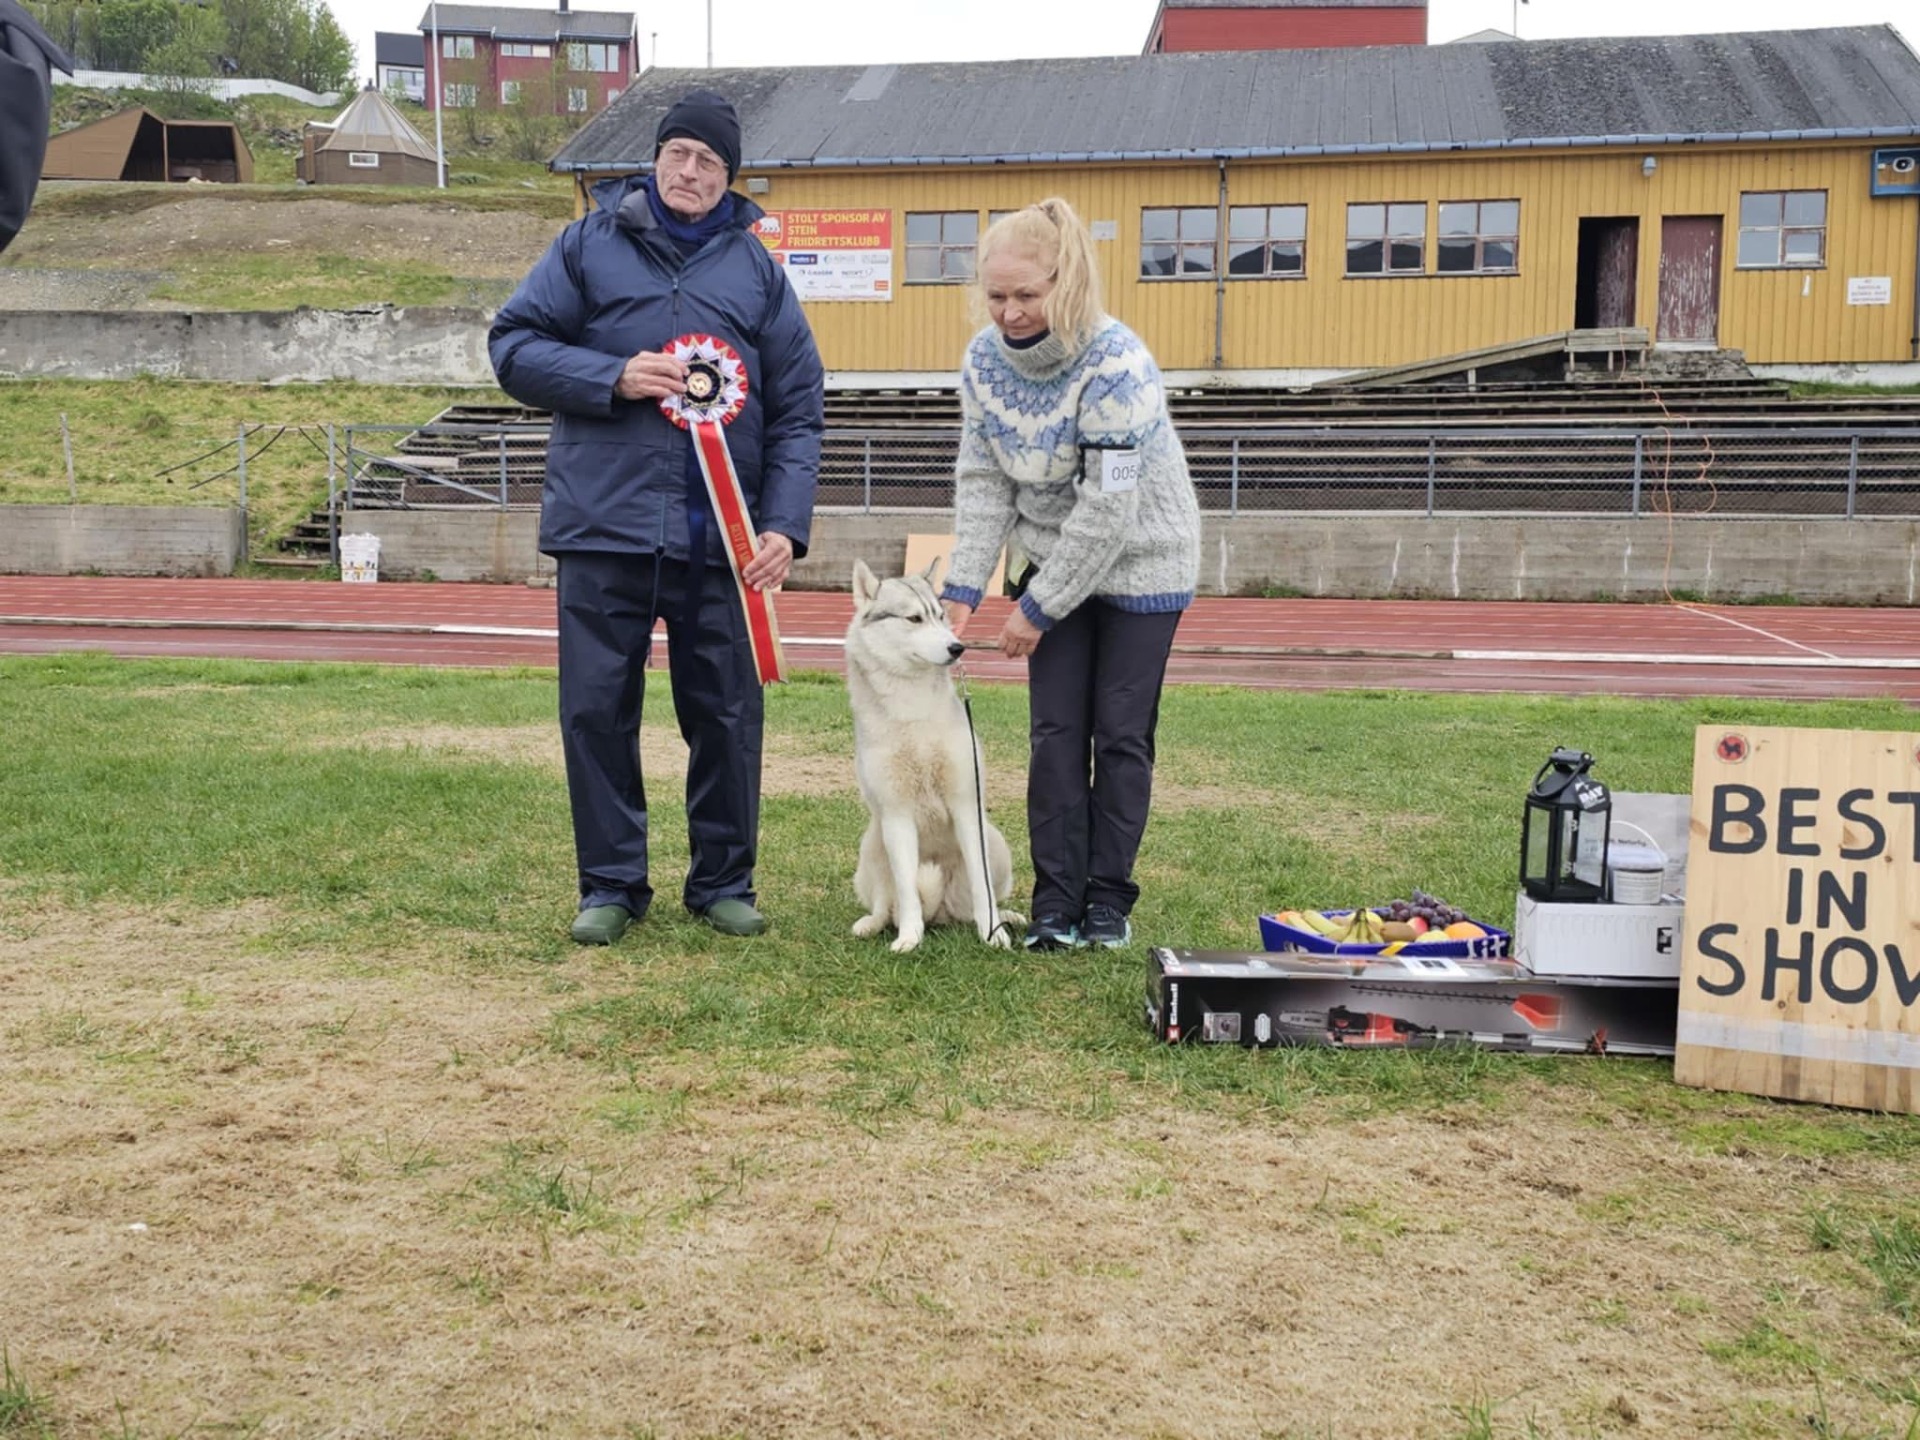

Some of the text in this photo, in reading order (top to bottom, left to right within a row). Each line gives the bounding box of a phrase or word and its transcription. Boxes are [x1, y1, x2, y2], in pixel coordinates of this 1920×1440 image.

[788, 213, 886, 223] STOLT SPONSOR AV
[788, 225, 817, 234] STEIN
[788, 236, 880, 247] FRIIDRETTSKLUBB
[1709, 784, 1920, 862] BEST
[1786, 868, 1867, 931] IN
